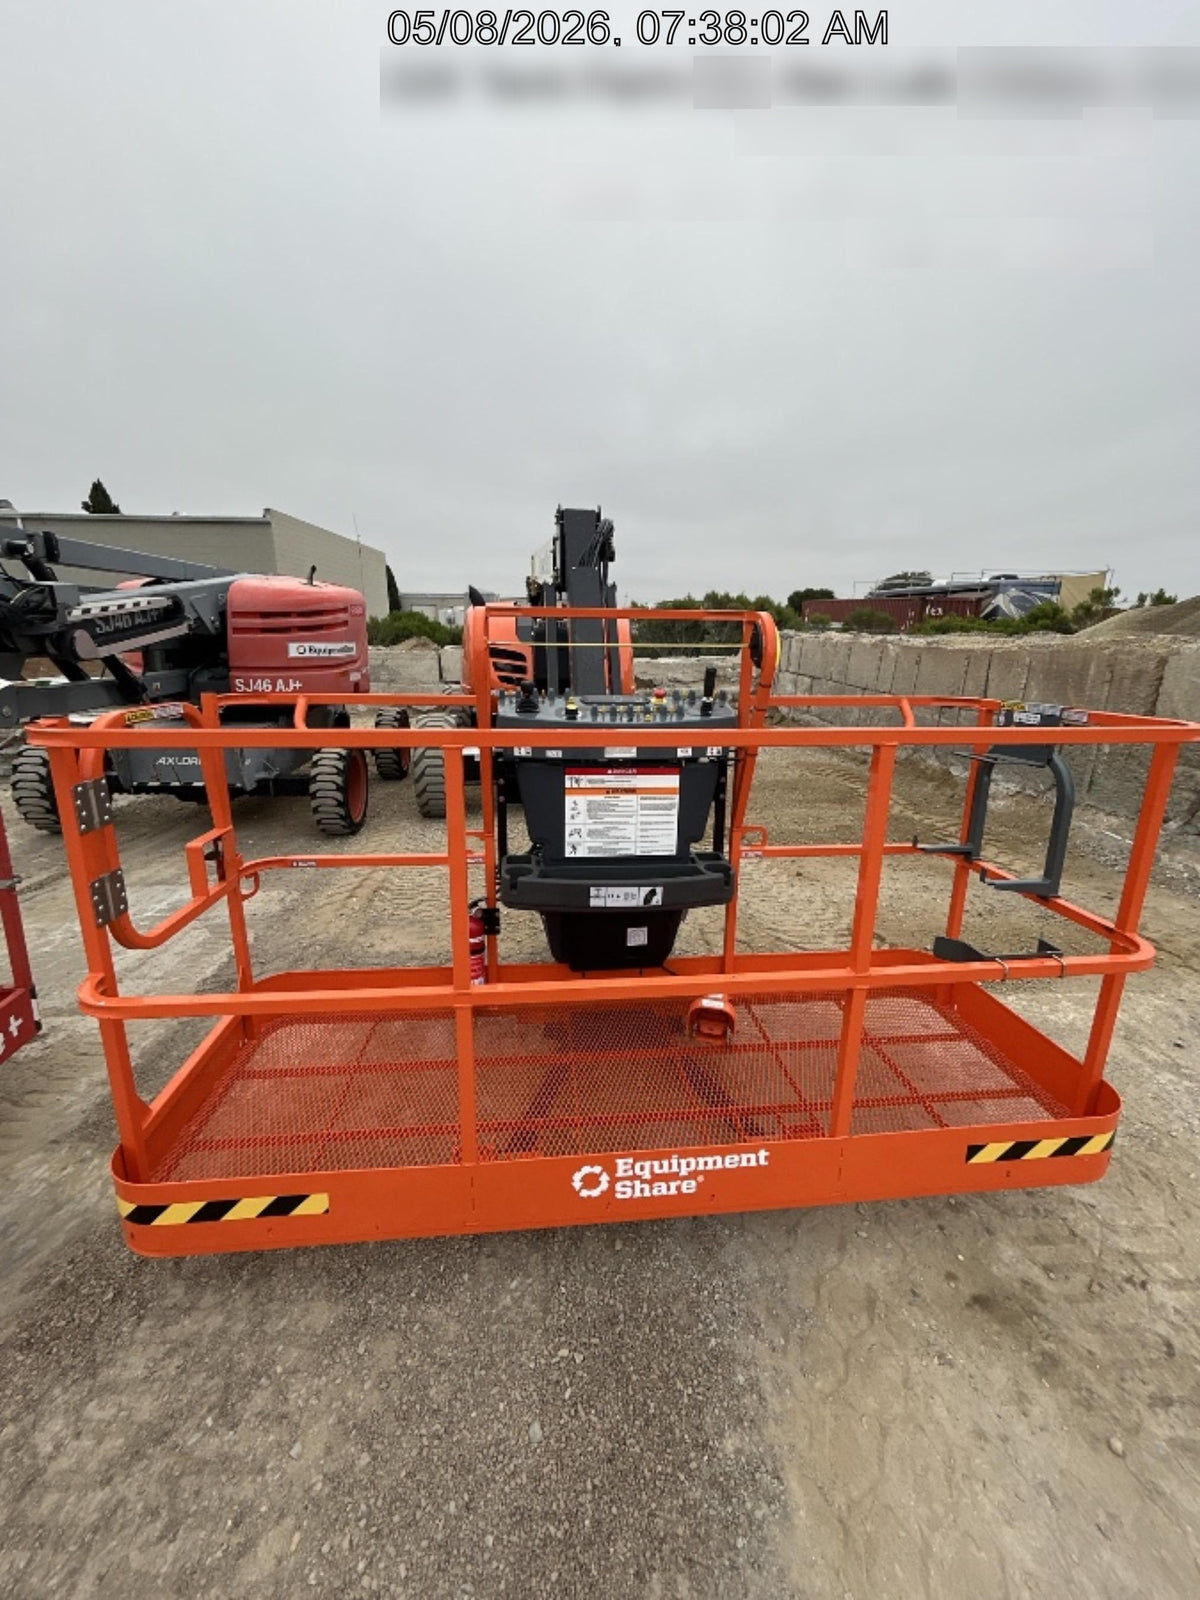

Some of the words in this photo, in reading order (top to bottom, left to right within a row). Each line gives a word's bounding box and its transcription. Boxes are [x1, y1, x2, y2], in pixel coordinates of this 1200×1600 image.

[235, 678, 272, 692] SJ46
[275, 678, 303, 692] AJ+
[614, 1148, 770, 1180] Equipment
